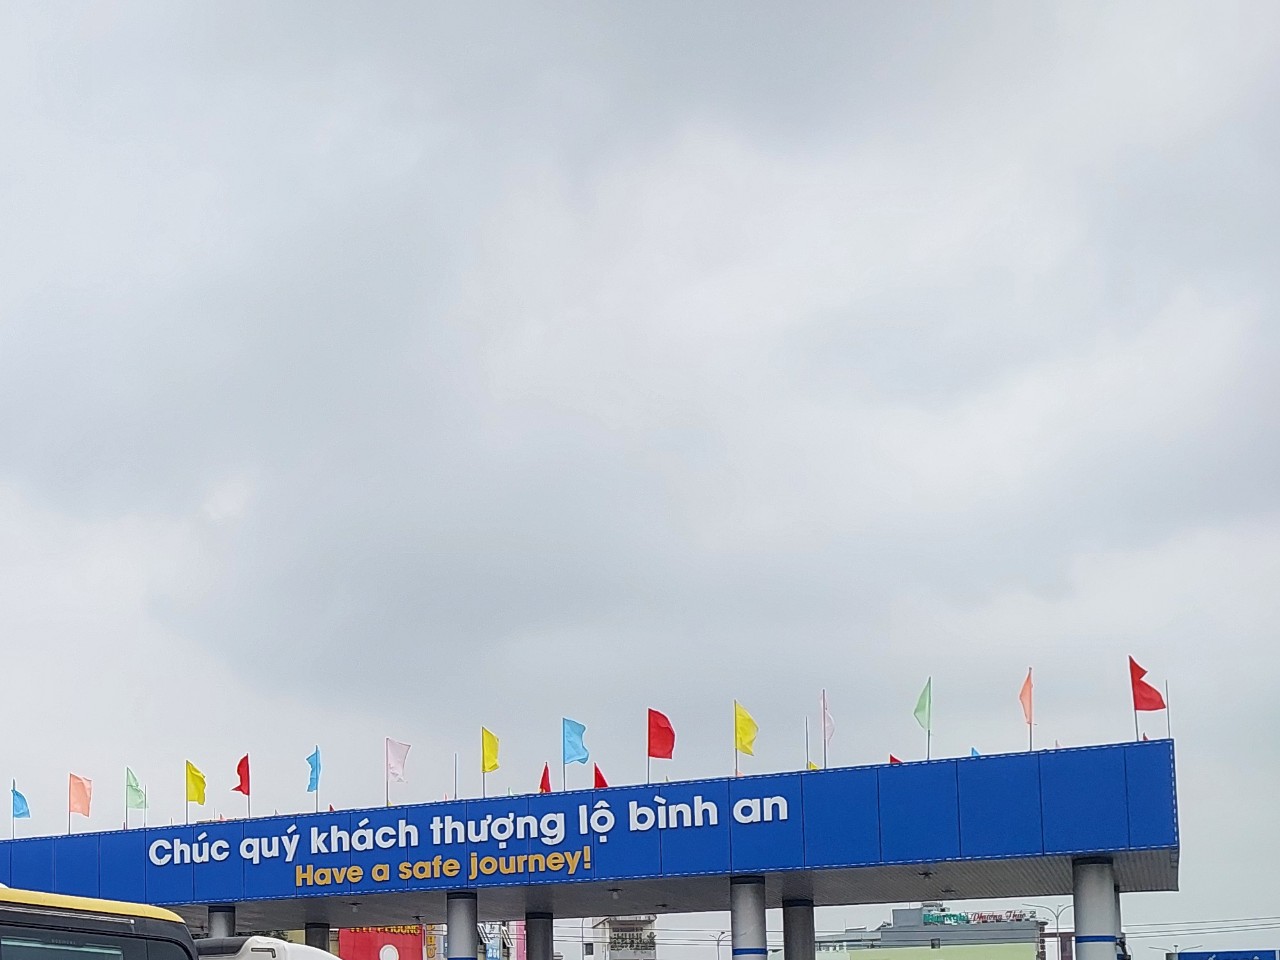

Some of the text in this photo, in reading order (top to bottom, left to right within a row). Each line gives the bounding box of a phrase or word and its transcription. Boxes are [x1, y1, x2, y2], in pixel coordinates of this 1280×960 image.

[148, 795, 788, 867] Chúc quý khách thượng lộ bình an
[295, 845, 592, 888] Have a safe journey!
